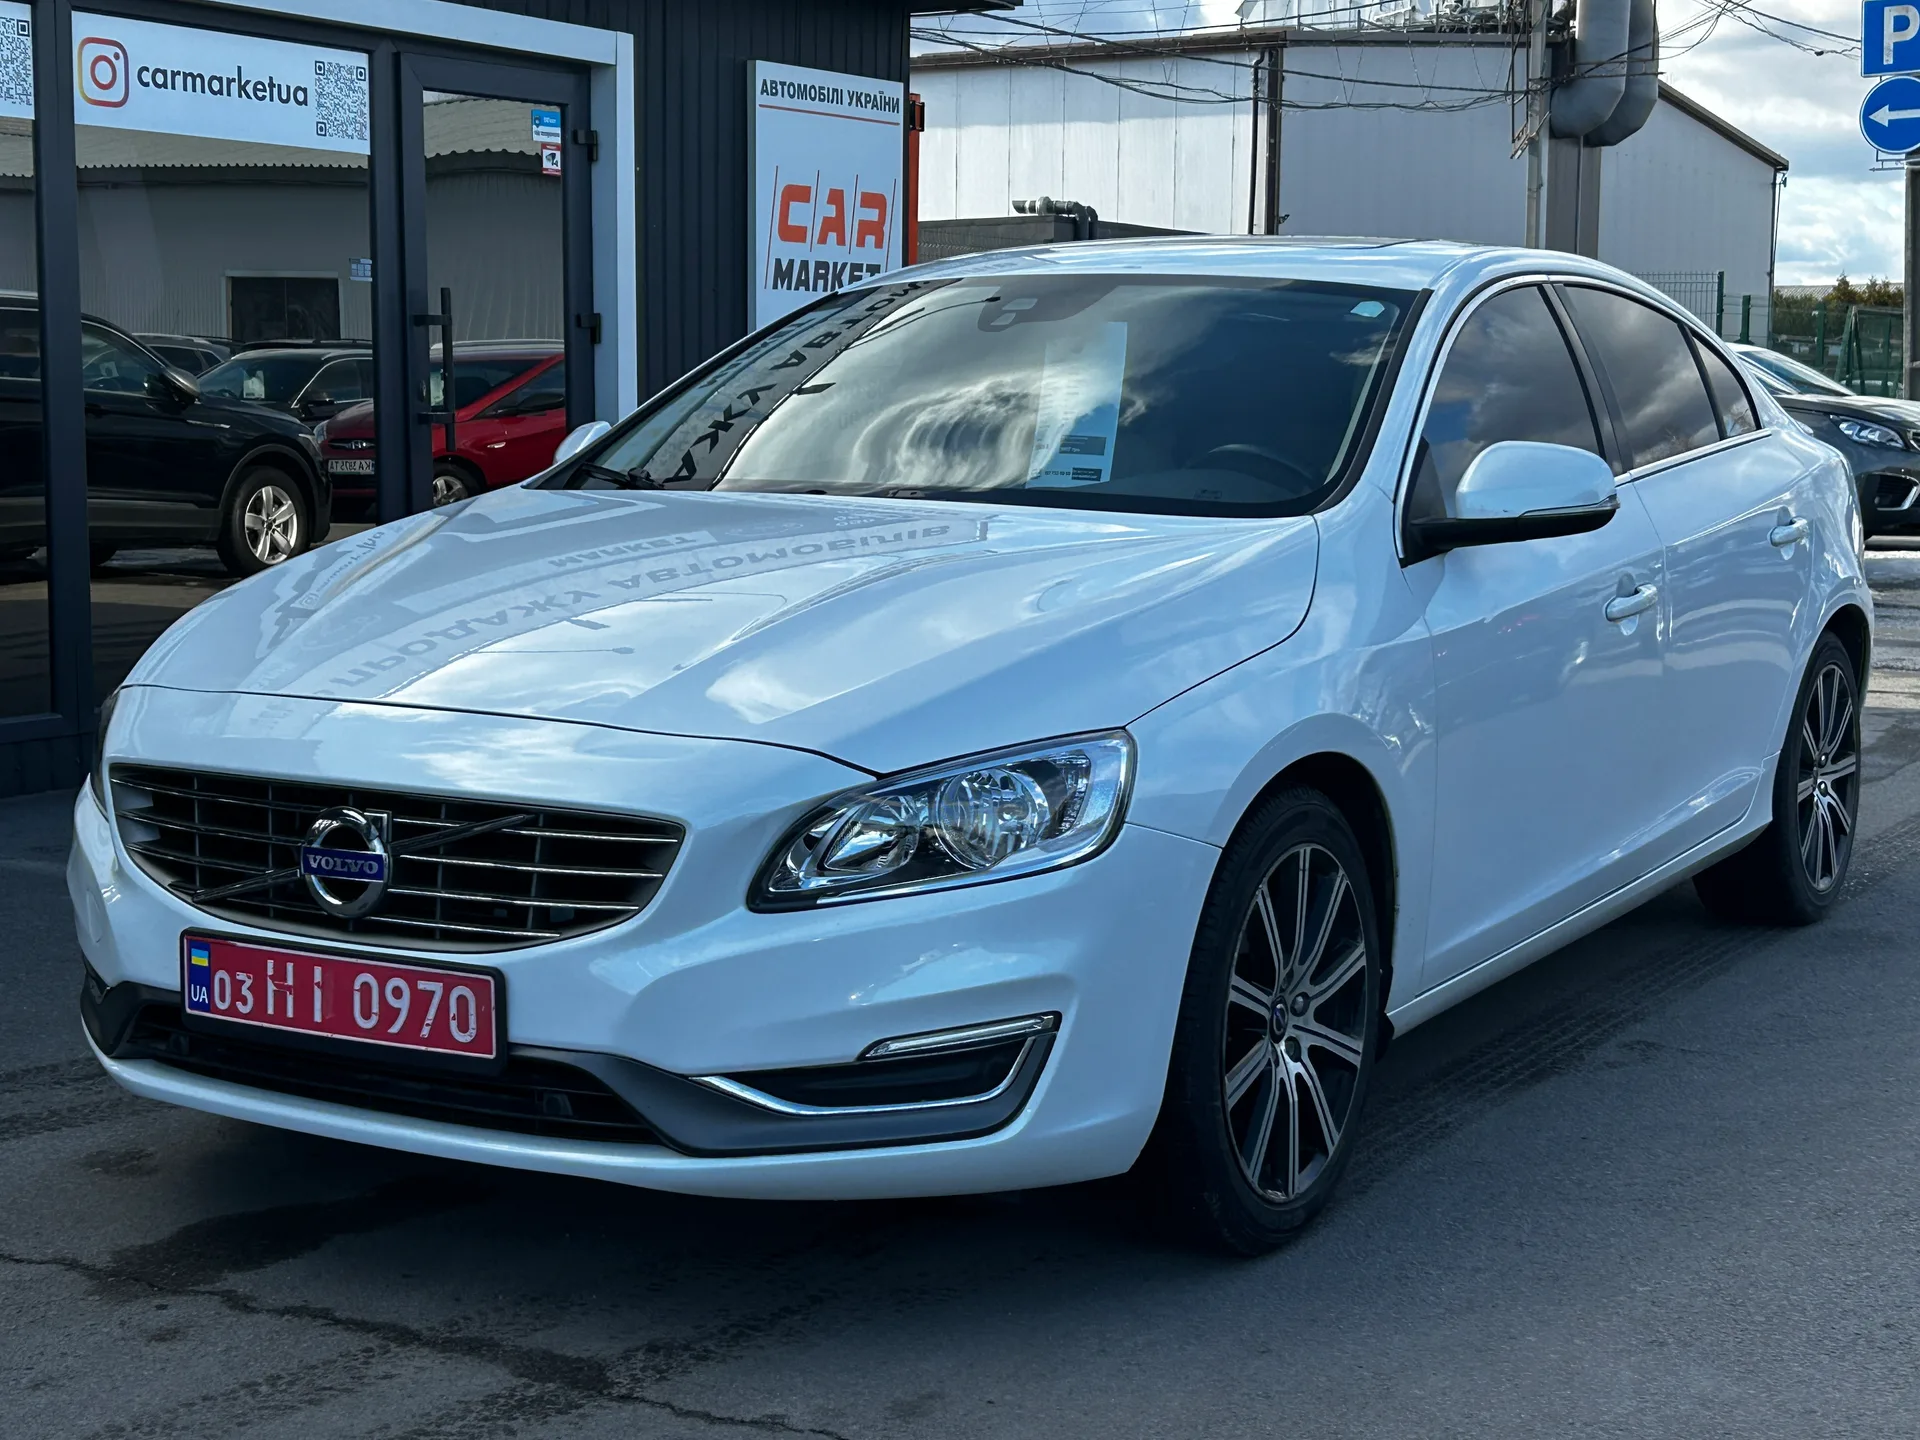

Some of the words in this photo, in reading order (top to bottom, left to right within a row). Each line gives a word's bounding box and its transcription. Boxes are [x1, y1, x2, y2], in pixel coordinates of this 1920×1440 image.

[1883, 4, 1919, 65] P
[137, 65, 308, 106] carmarketua
[760, 78, 843, 105] АВТОМОБІЛІ
[847, 90, 900, 114] УКРАЇНИ
[777, 184, 887, 249] CAR
[306, 854, 379, 875] VOLVO
[191, 984, 209, 1005] UA
[213, 969, 254, 1015] 03
[353, 972, 477, 1044] 0970
